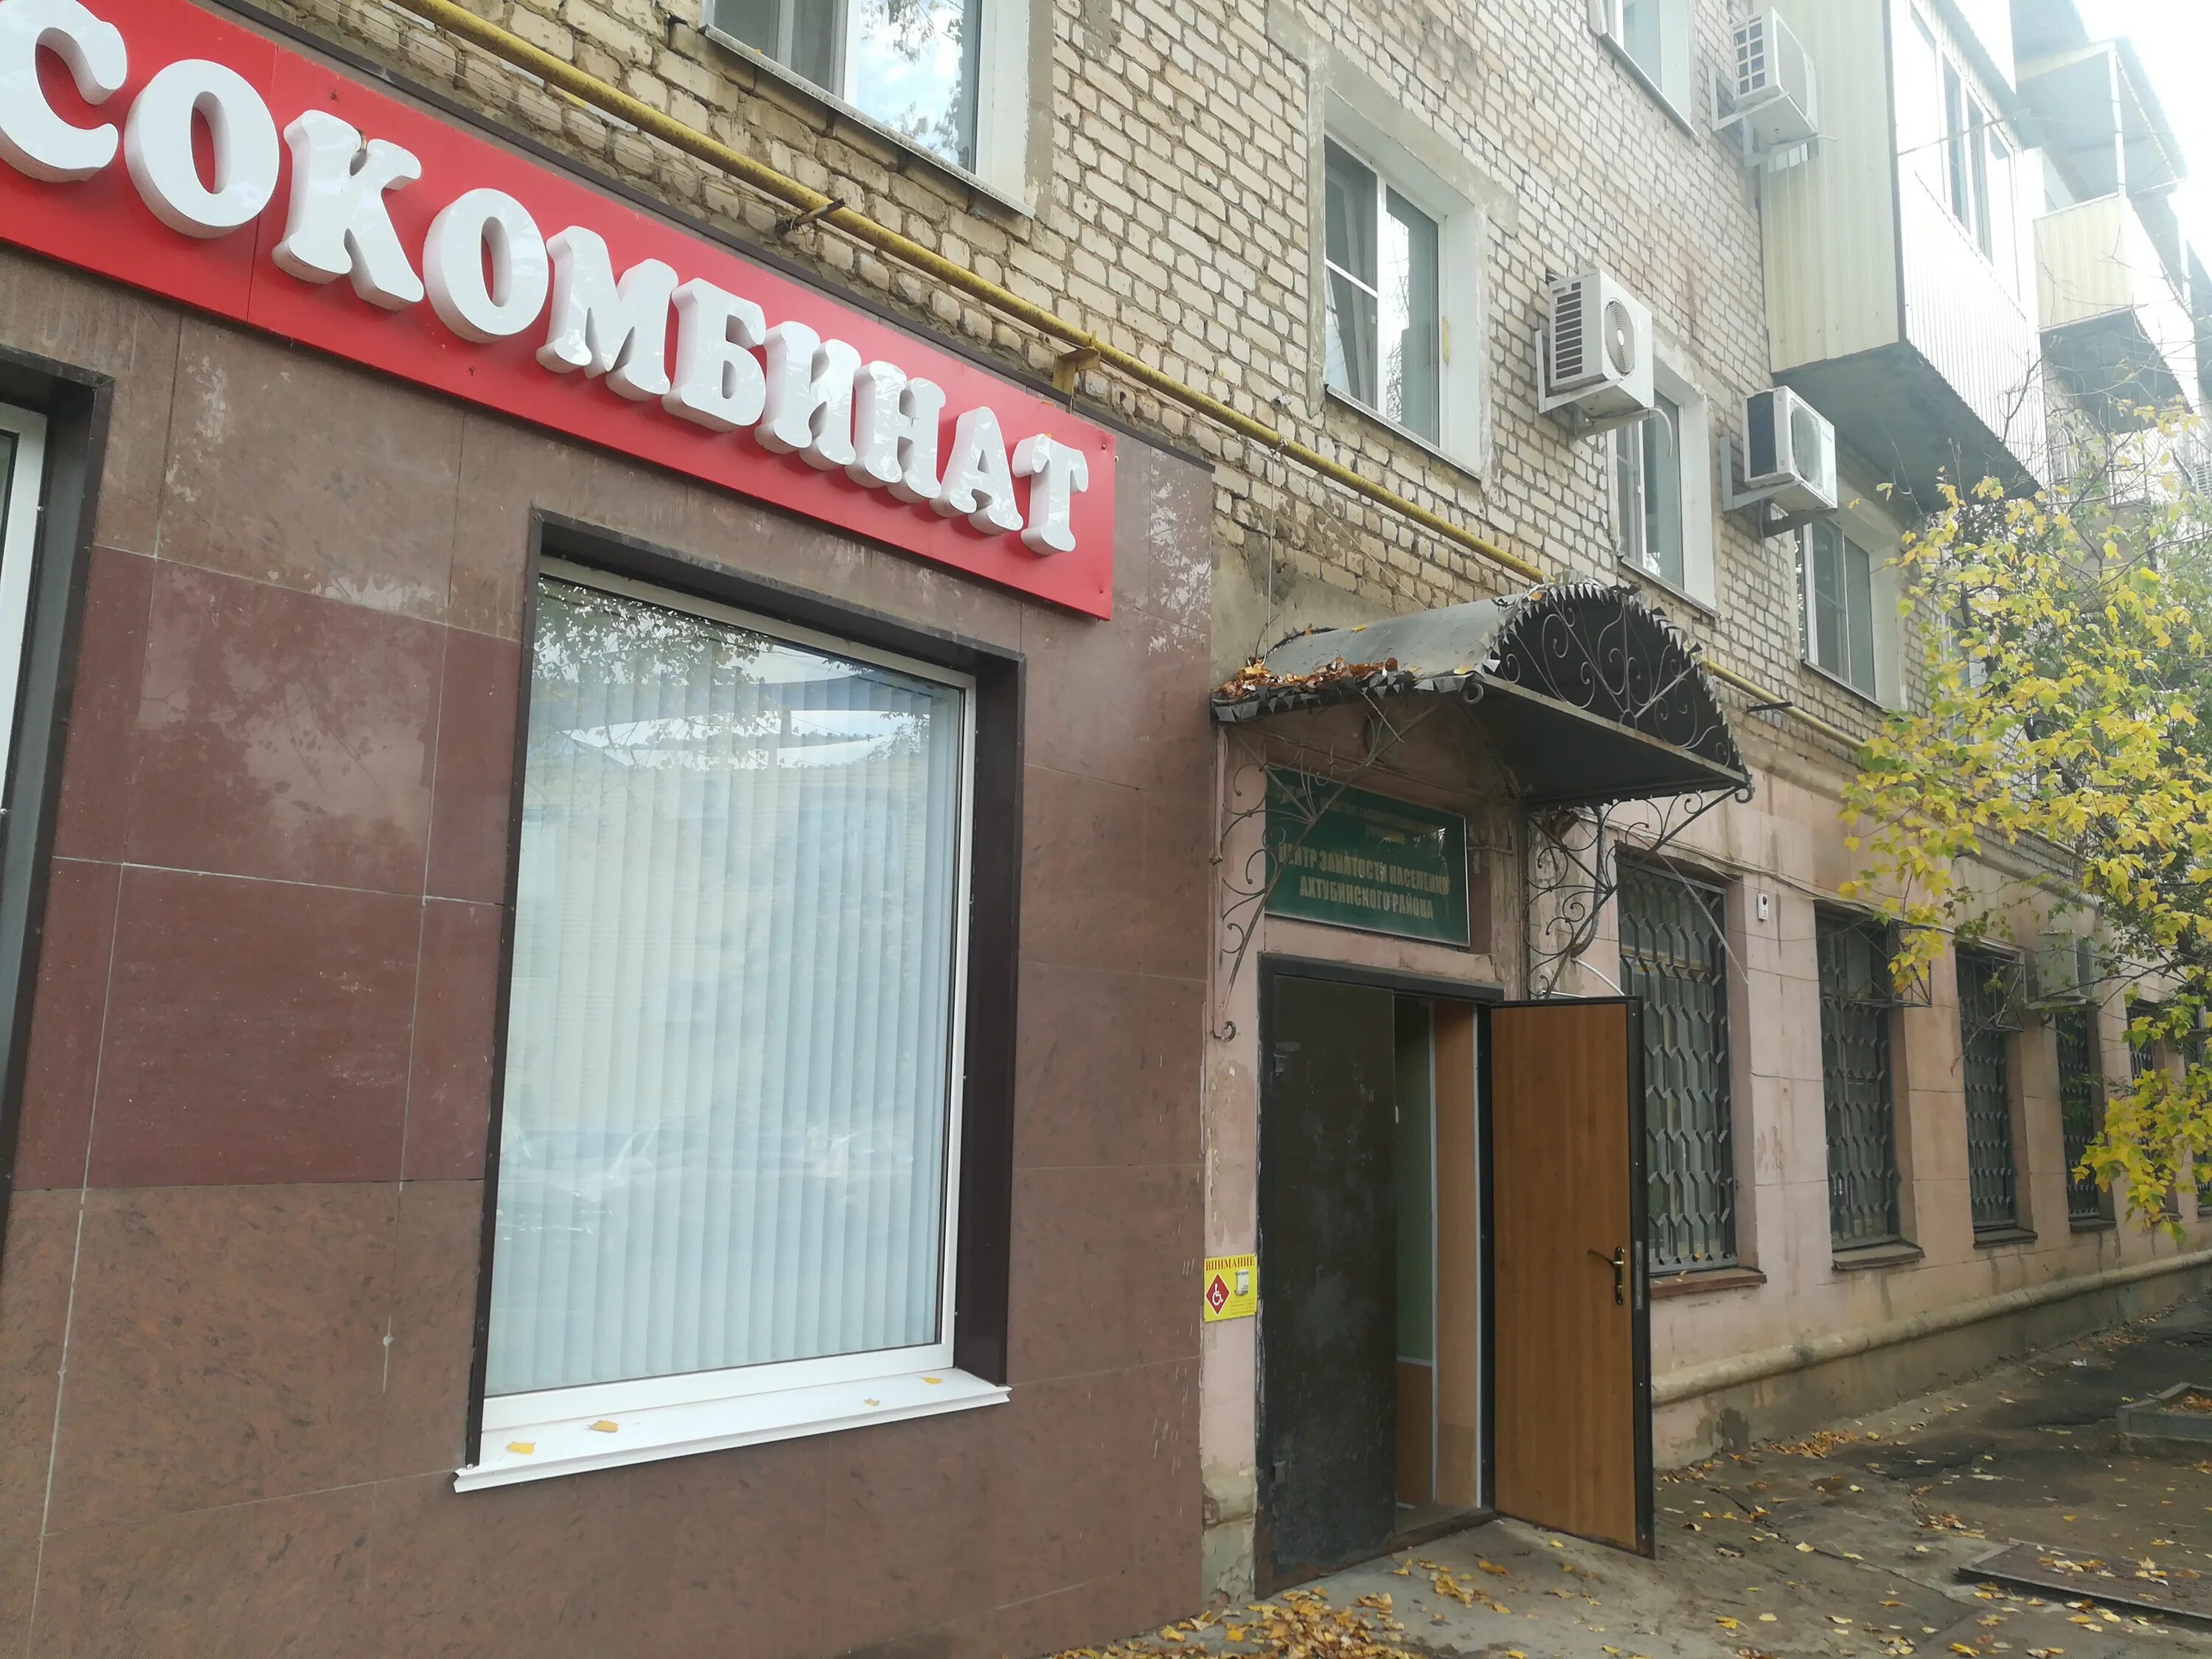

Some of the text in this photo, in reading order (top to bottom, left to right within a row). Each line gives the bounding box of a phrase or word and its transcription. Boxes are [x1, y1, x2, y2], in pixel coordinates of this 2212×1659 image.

[1319, 850, 1387, 883] ЗАНЯТОСТИ
[1389, 865, 1450, 895] НАСЕЛЕНИЯ
[1300, 875, 1434, 919] АХТУБИНСКОГО РАЙОНА
[1206, 1256, 1255, 1271] ВНИМАНИЕ
